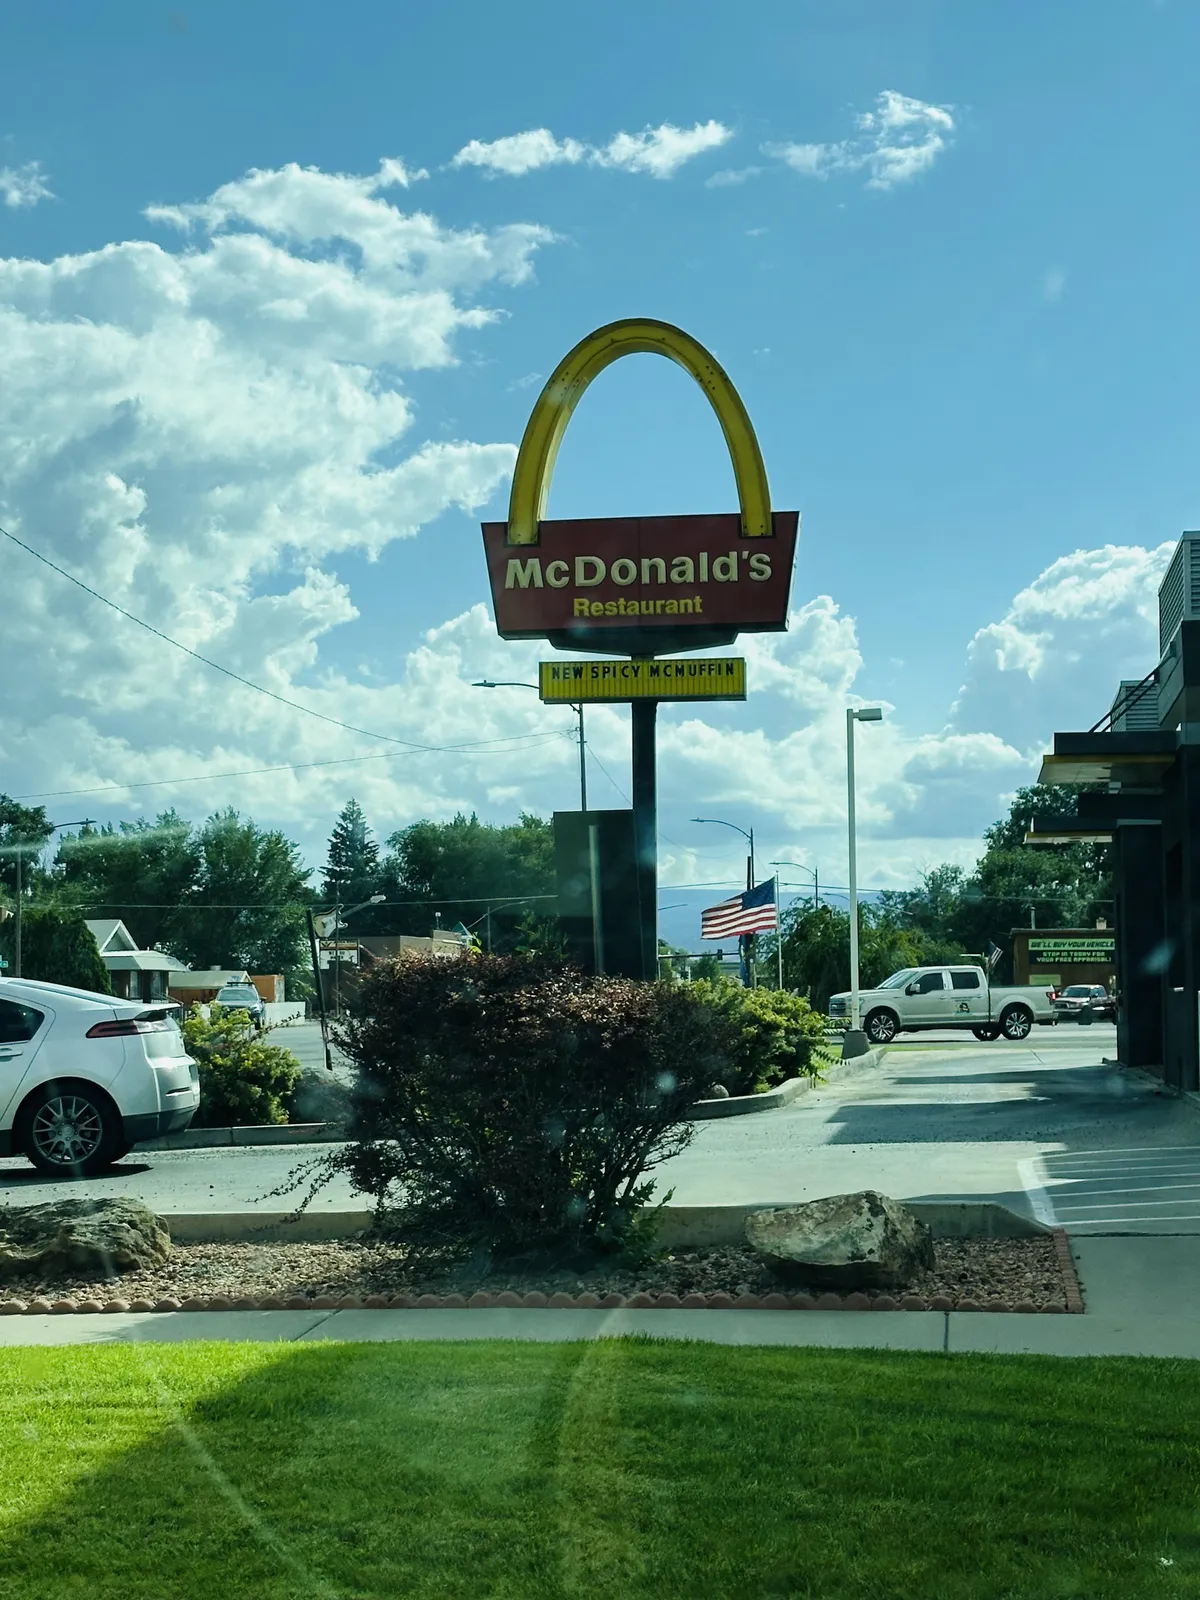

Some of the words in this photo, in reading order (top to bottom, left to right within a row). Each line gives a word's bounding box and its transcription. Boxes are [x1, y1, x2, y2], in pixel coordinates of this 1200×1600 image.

[505, 551, 772, 589] McDonald's
[573, 595, 703, 618] Restaurant
[552, 666, 583, 680] NEW
[591, 665, 641, 679] SPICY
[649, 662, 735, 678] MCMUFFIN
